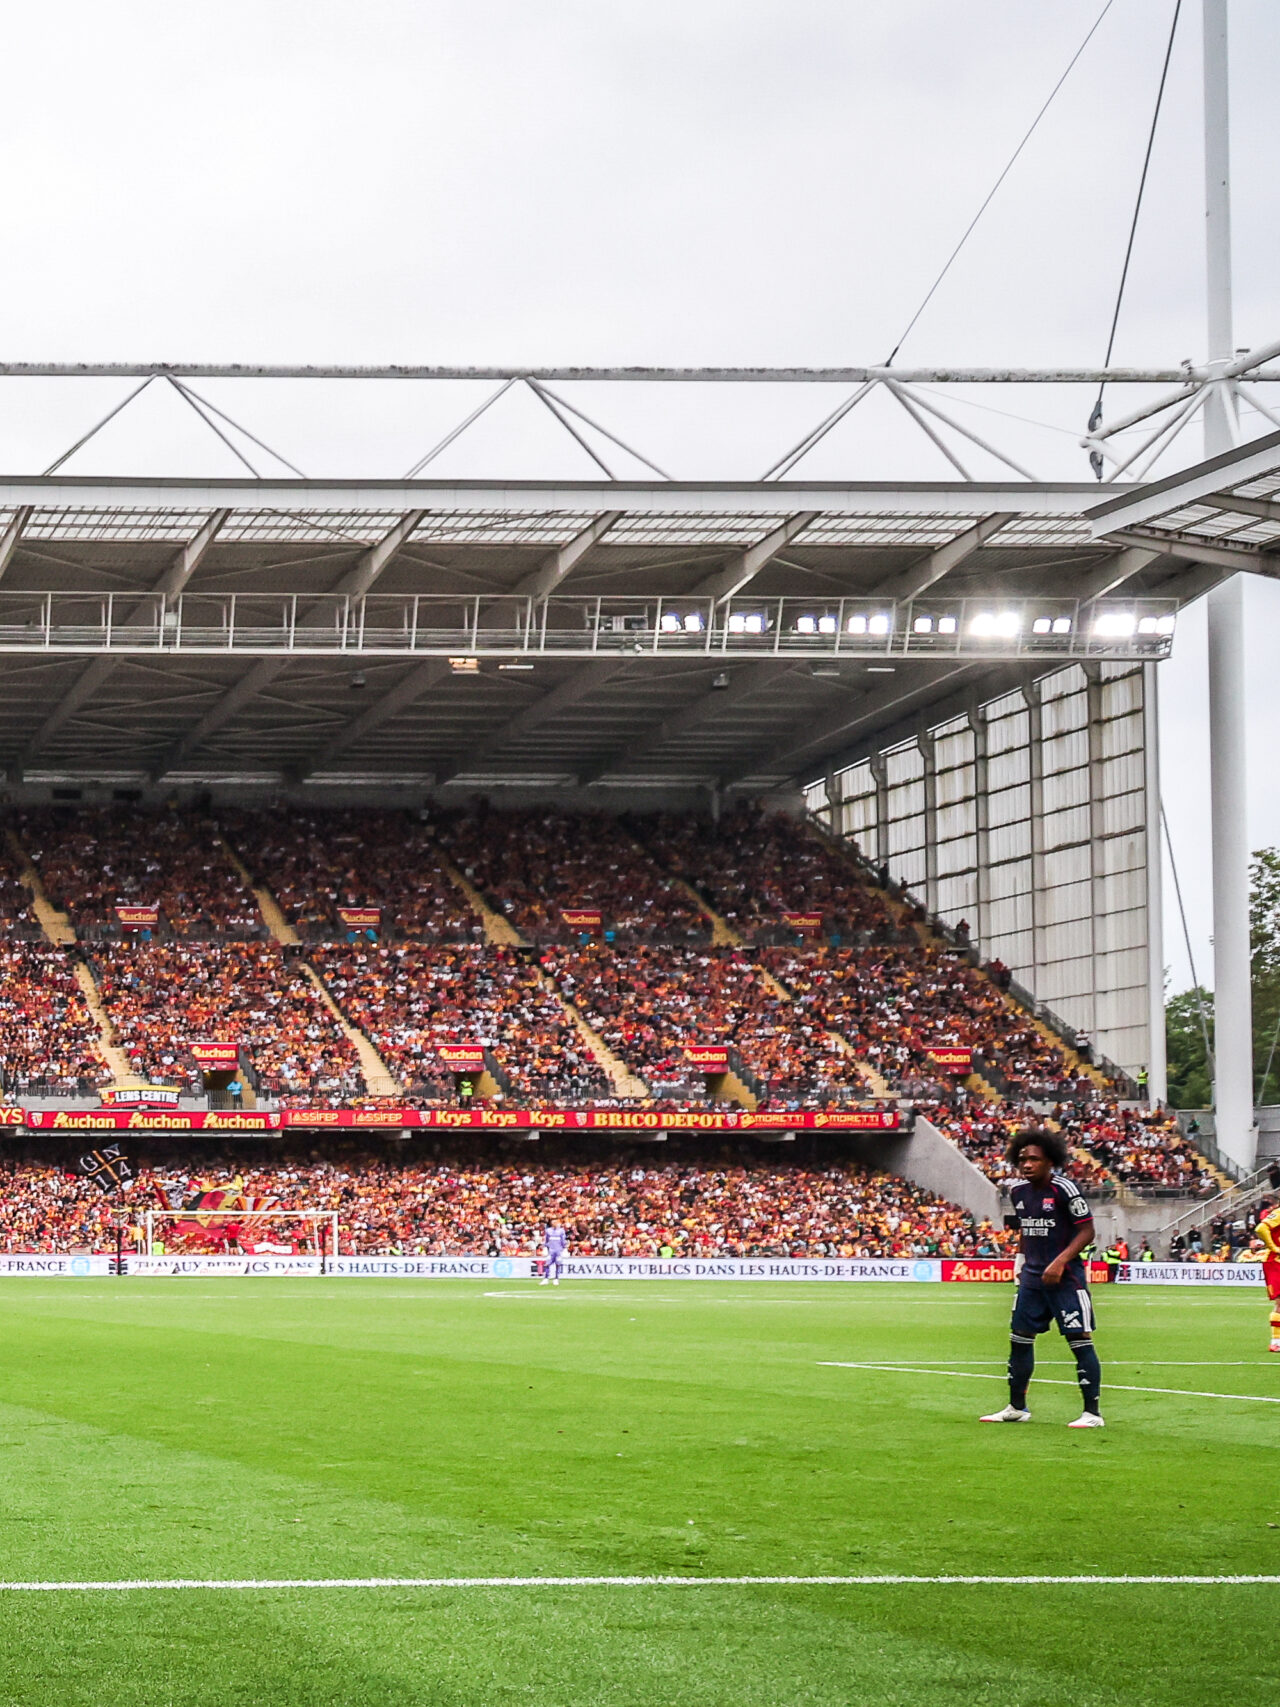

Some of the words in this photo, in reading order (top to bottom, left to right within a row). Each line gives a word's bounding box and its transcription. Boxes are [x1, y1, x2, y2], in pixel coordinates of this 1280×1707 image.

[118, 909, 158, 921] Auchan
[340, 911, 380, 922] Auchan
[561, 912, 601, 924] Auchan
[782, 915, 821, 926] Auchan
[192, 1045, 236, 1058] Auchan
[439, 1047, 482, 1060] Auchan
[683, 1049, 727, 1062] Auchan
[927, 1051, 970, 1063] Auchan
[115, 1090, 140, 1103] LENS
[141, 1090, 179, 1104] CENTRE
[53, 1112, 116, 1129] Auchan
[128, 1112, 191, 1129] Auchan
[202, 1112, 265, 1129] Auchan
[435, 1110, 472, 1127] Krys
[481, 1110, 518, 1127] Krys
[529, 1110, 566, 1127] Krys
[594, 1112, 658, 1127] BRICO
[661, 1112, 726, 1127] DEPOT
[755, 1114, 805, 1123] MORETTI
[829, 1114, 879, 1123] MORETTI
[1019, 1216, 1056, 1227] mirates
[350, 1262, 489, 1273] HAUTS-DE-FRANCE
[559, 1263, 623, 1274] TRAVAUX
[629, 1264, 691, 1275] PUBLICS
[696, 1264, 735, 1275] DANS
[740, 1264, 765, 1275] LES
[770, 1264, 910, 1276] HAUTS-DE-FRANCE
[950, 1262, 1014, 1281] Aucha
[1135, 1267, 1178, 1279] TRAVAUX
[1182, 1268, 1225, 1280] PUBLICS
[1227, 1268, 1256, 1281] DANS
